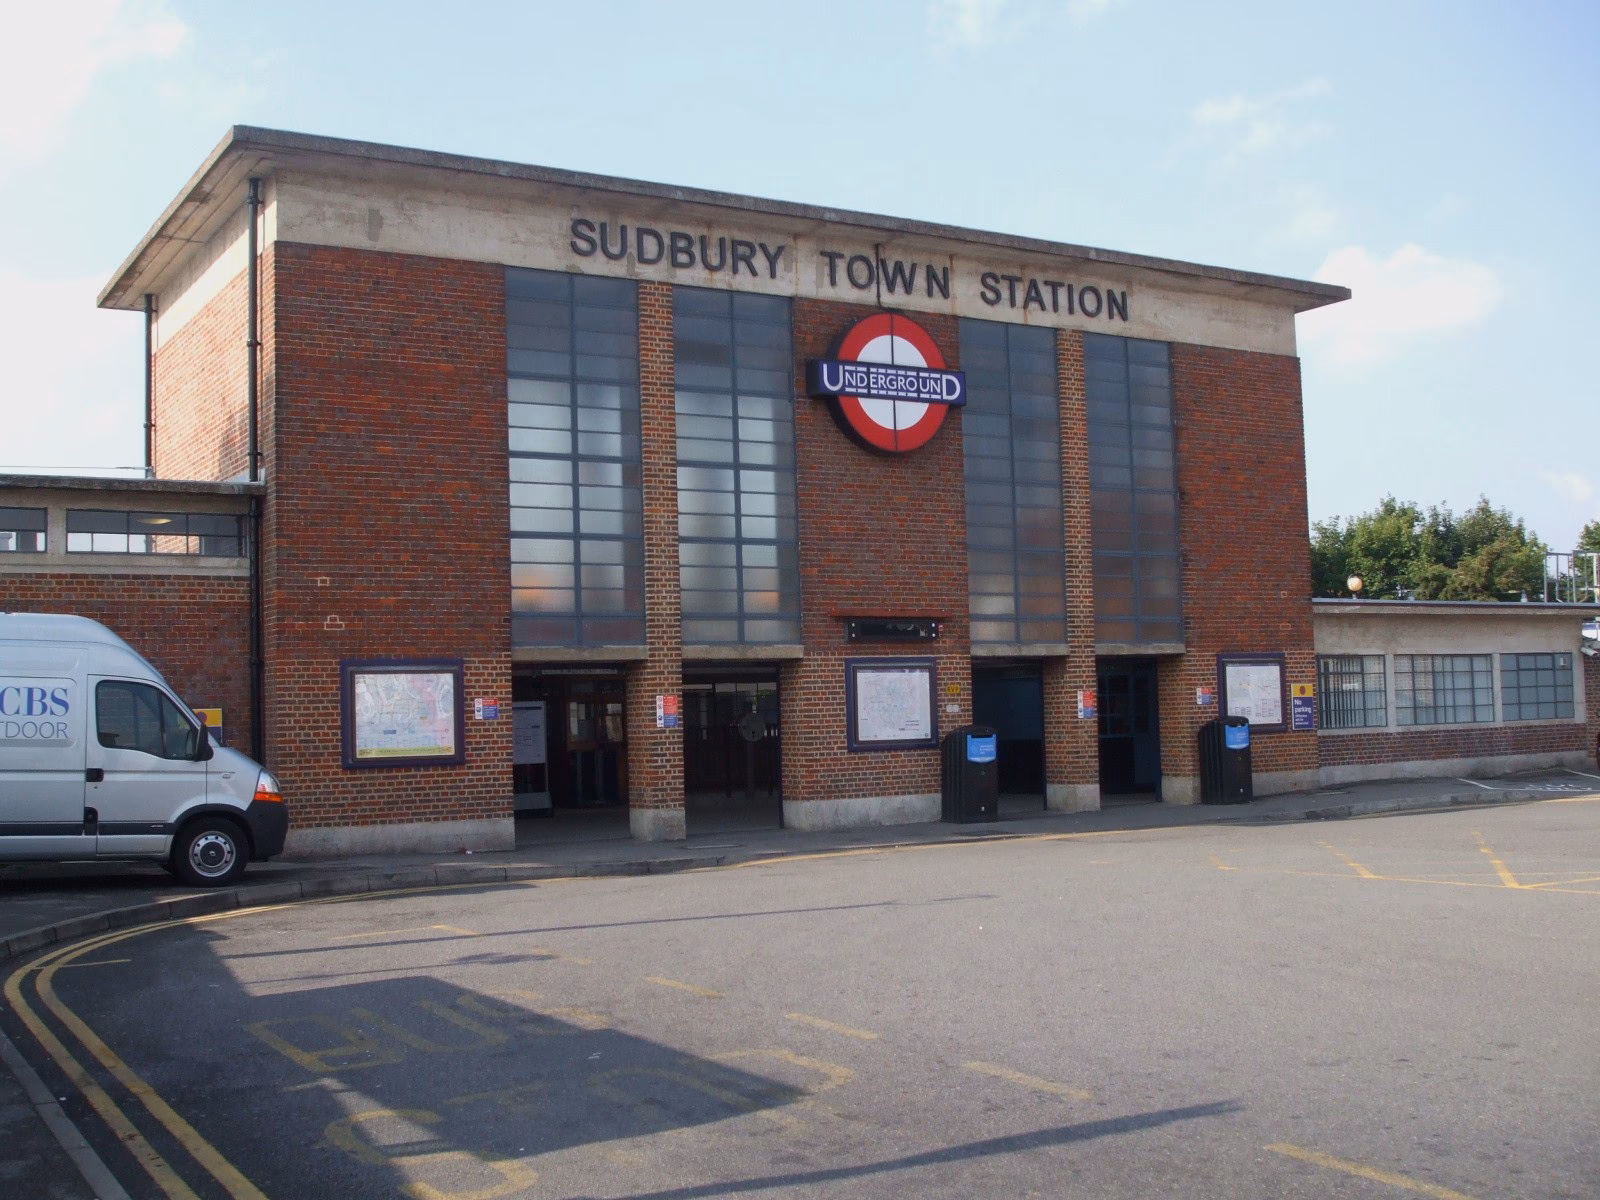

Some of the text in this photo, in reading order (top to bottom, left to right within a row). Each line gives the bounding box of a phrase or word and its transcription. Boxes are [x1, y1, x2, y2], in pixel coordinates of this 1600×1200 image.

[570, 218, 1129, 322] SUDBURY TOWN STATION
[0, 686, 70, 717] CBS
